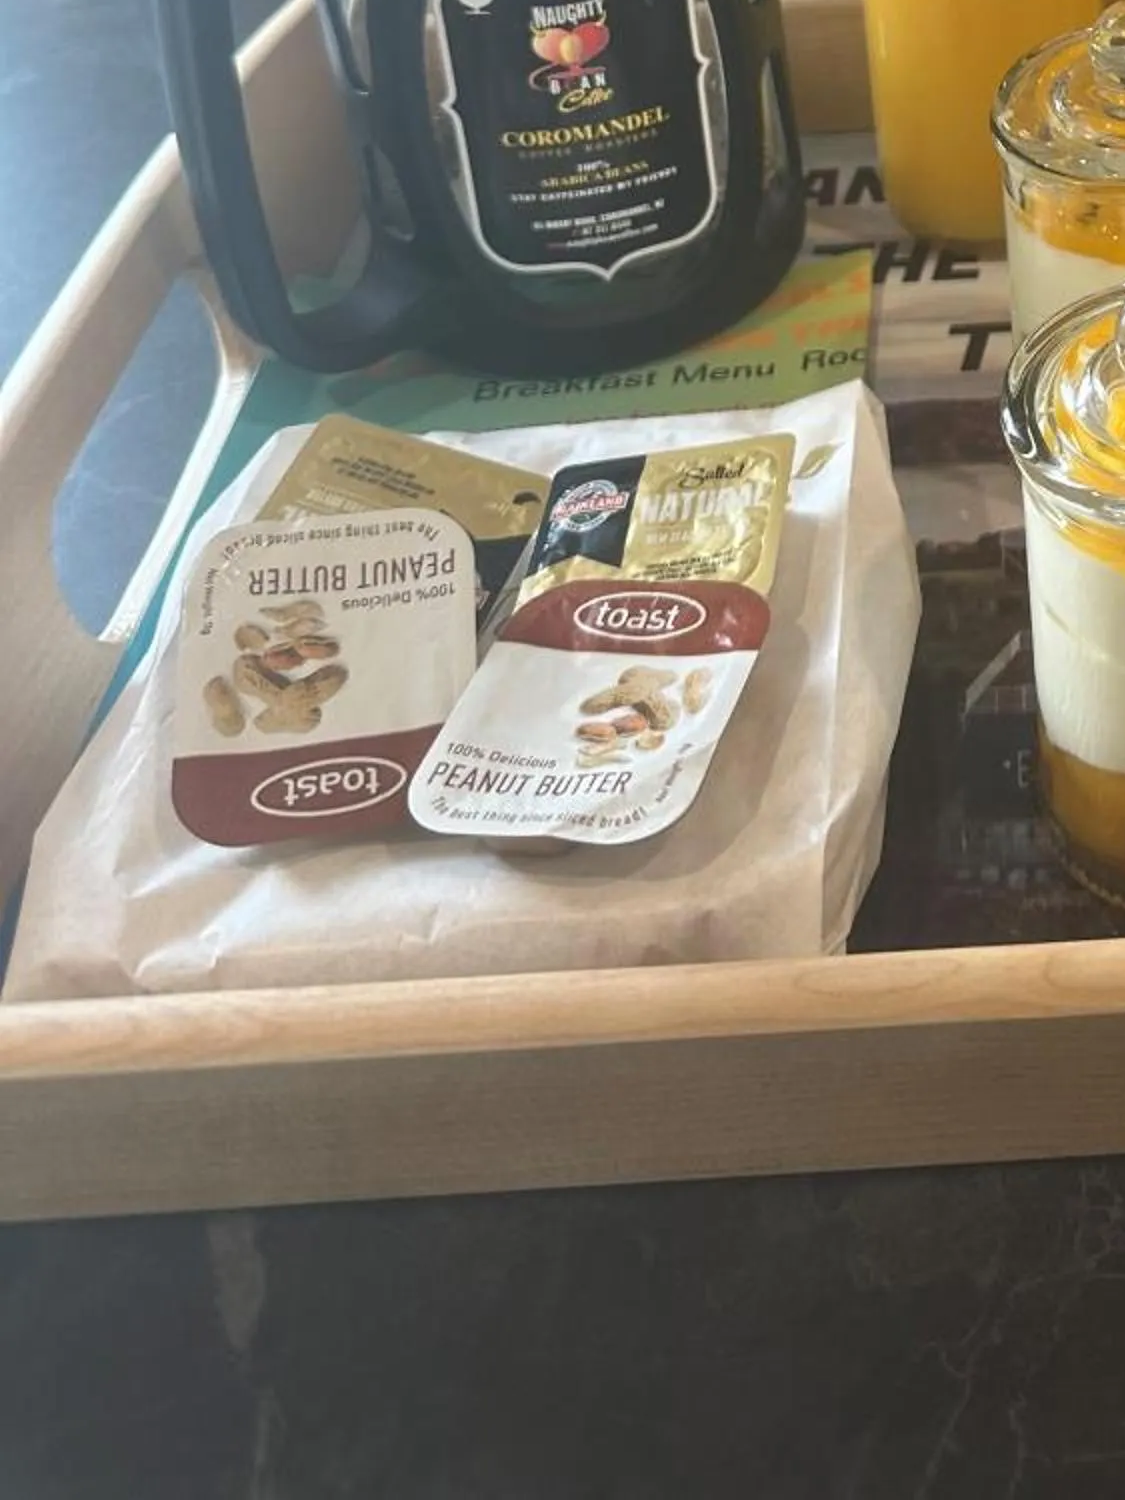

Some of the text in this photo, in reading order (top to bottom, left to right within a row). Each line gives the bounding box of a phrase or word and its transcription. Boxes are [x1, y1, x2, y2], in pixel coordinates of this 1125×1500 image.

[502, 105, 670, 148] COROMANDEL
[474, 369, 657, 403] Breakfast
[672, 361, 776, 386] Menu
[677, 461, 746, 488] Salted
[308, 527, 342, 541] since
[345, 523, 380, 538] thing
[385, 520, 415, 534] best
[417, 521, 440, 542] The
[249, 549, 455, 596] PEANUT BUTTER
[342, 582, 455, 612] 100% Delicious
[595, 601, 681, 632] toast
[447, 743, 557, 769] 100% Delicious
[284, 767, 380, 807] toast
[427, 761, 535, 797] PEANUT
[535, 771, 633, 797] BUTTER
